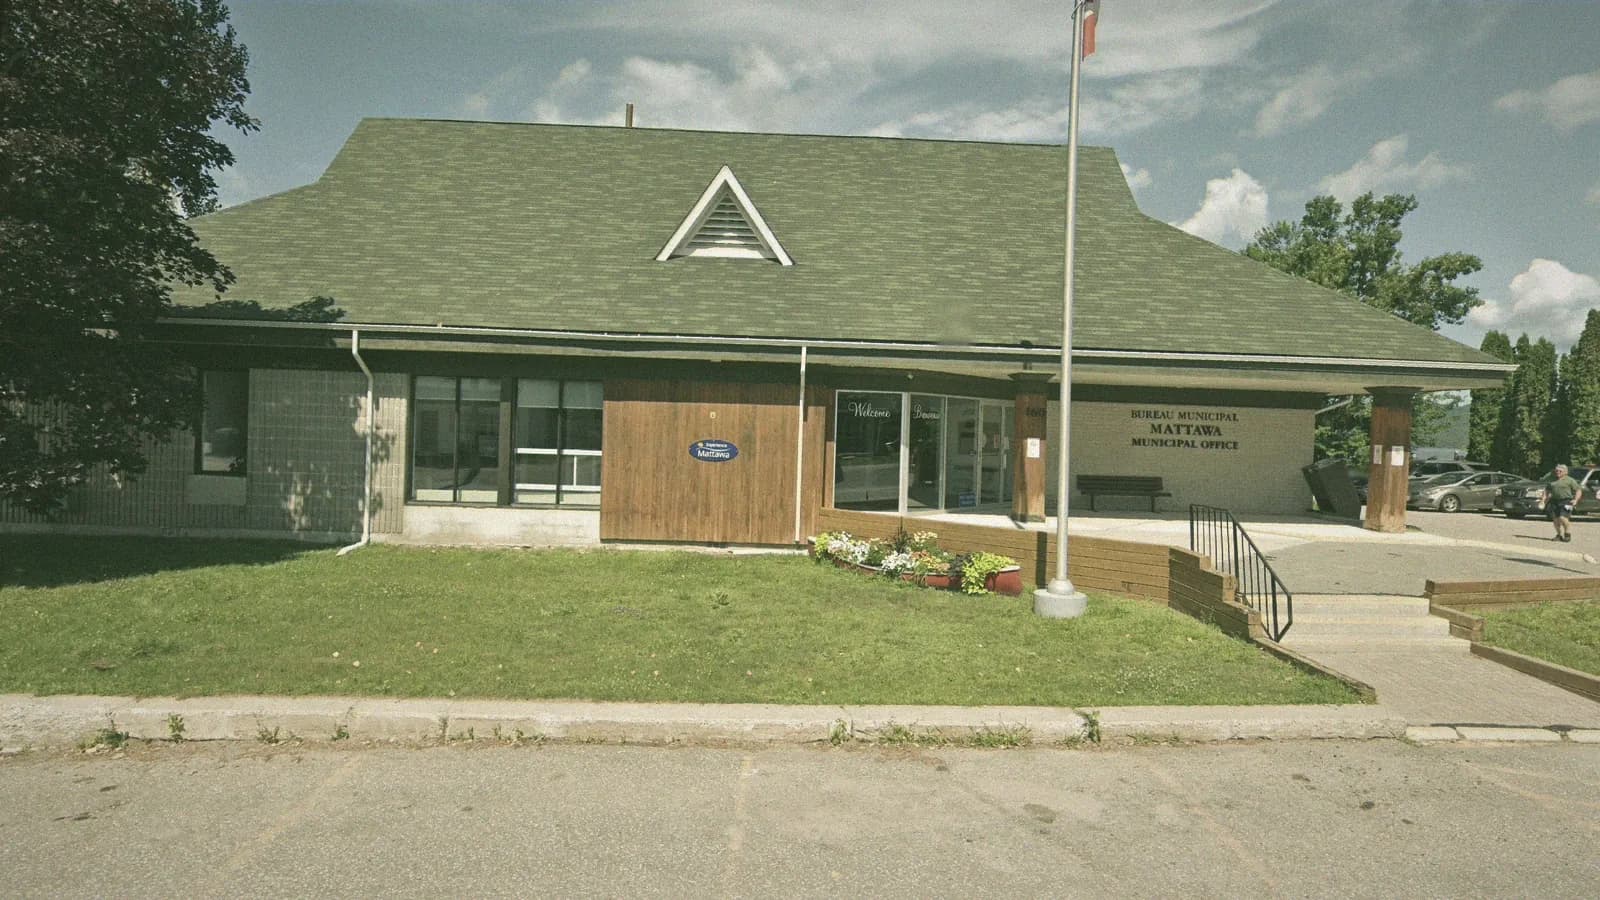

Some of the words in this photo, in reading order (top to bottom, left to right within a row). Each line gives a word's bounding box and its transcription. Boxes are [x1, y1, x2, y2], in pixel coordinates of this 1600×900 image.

[848, 402, 891, 418] Welcome
[1131, 410, 1174, 419] BUREAU
[1178, 411, 1239, 422] MUNICIPAL
[1151, 424, 1222, 436] MATTAWA
[1132, 438, 1198, 448] MUNICIPAL
[1200, 441, 1239, 450] OFFICE
[697, 450, 730, 459] Mattawa
